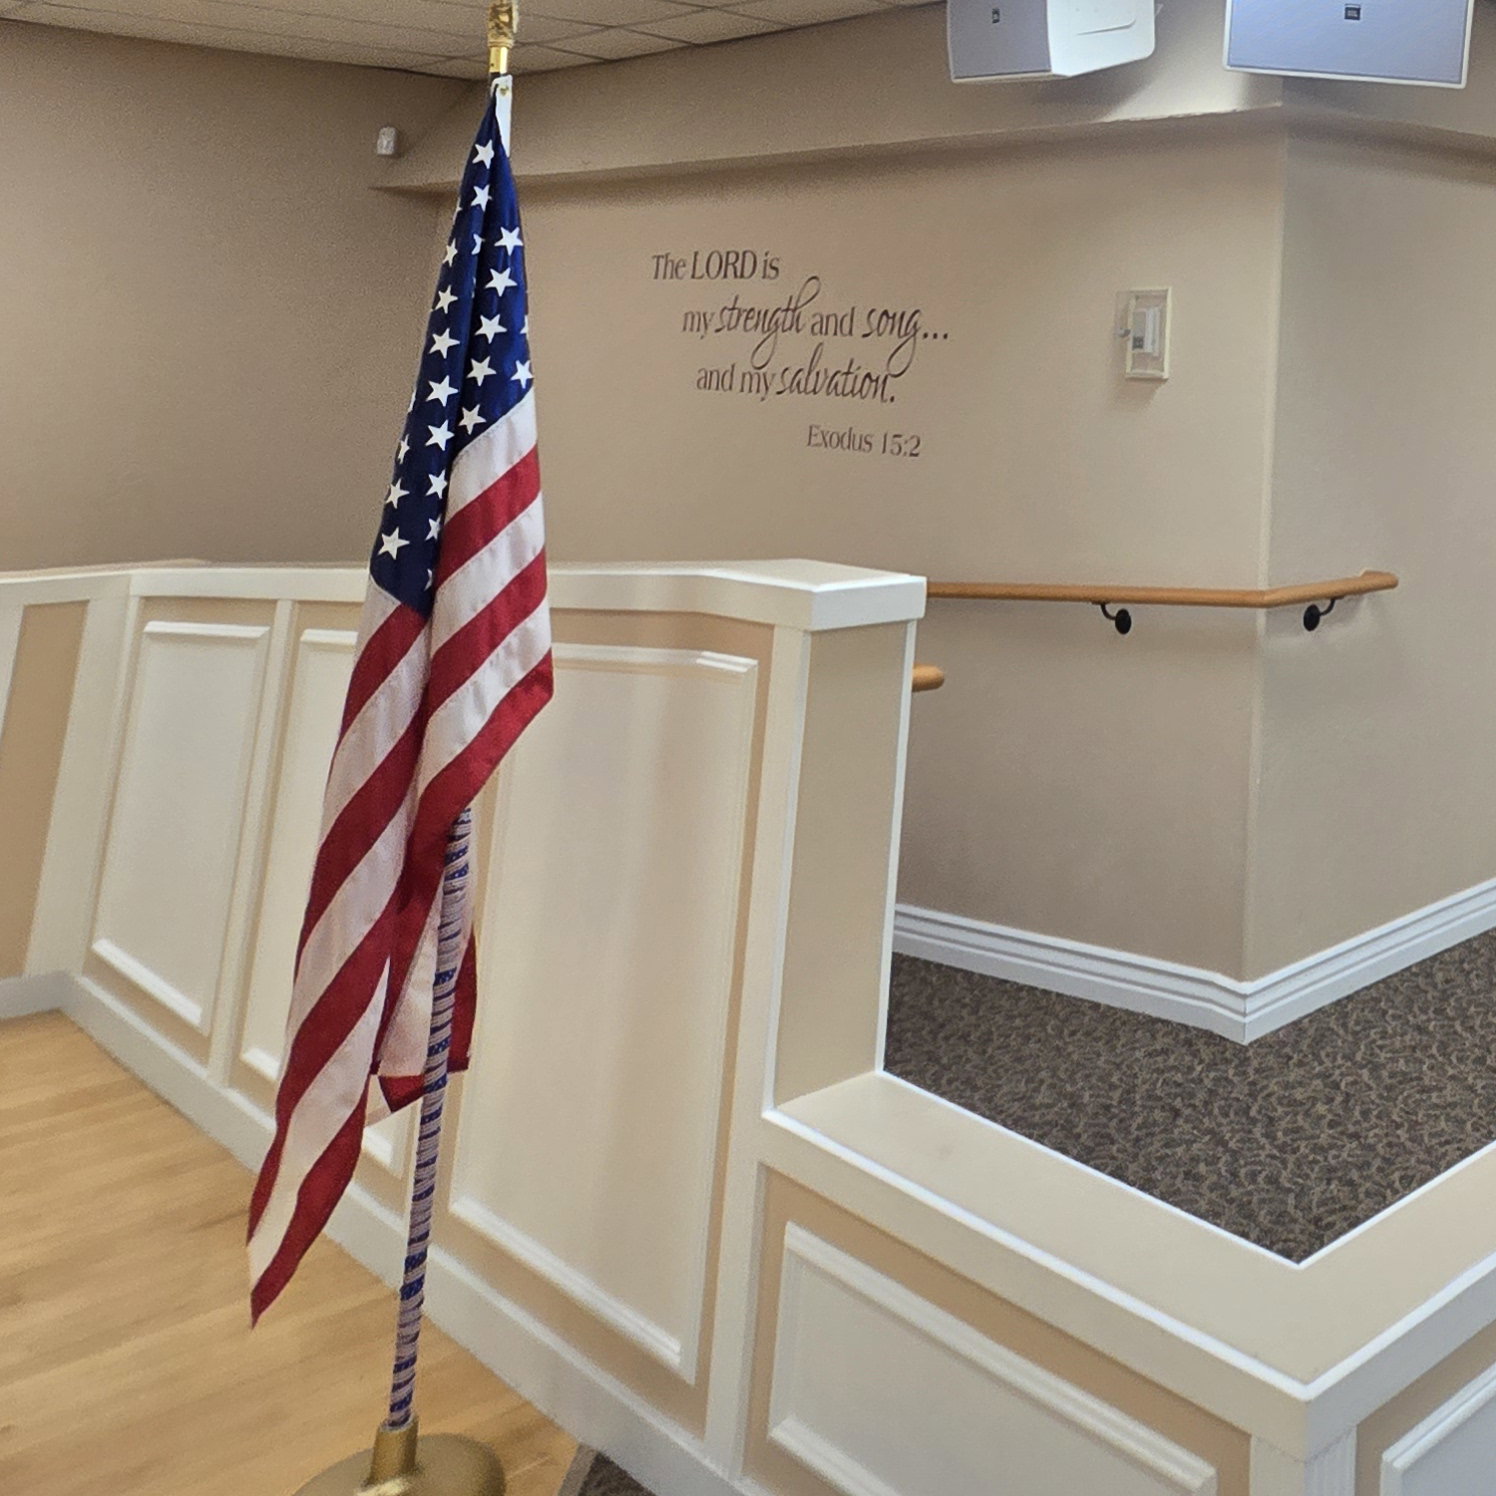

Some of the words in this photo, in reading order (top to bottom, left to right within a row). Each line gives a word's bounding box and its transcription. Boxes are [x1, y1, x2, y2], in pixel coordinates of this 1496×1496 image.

[652, 252, 687, 280] The
[691, 249, 758, 280] LORD
[761, 250, 780, 280] is
[682, 309, 713, 339] my
[714, 276, 821, 370] strength
[810, 306, 855, 337] and
[696, 362, 735, 392] and
[739, 369, 776, 402] my
[775, 342, 895, 403] salvation.
[807, 424, 873, 453] Exodus
[881, 431, 922, 457] 15:2
